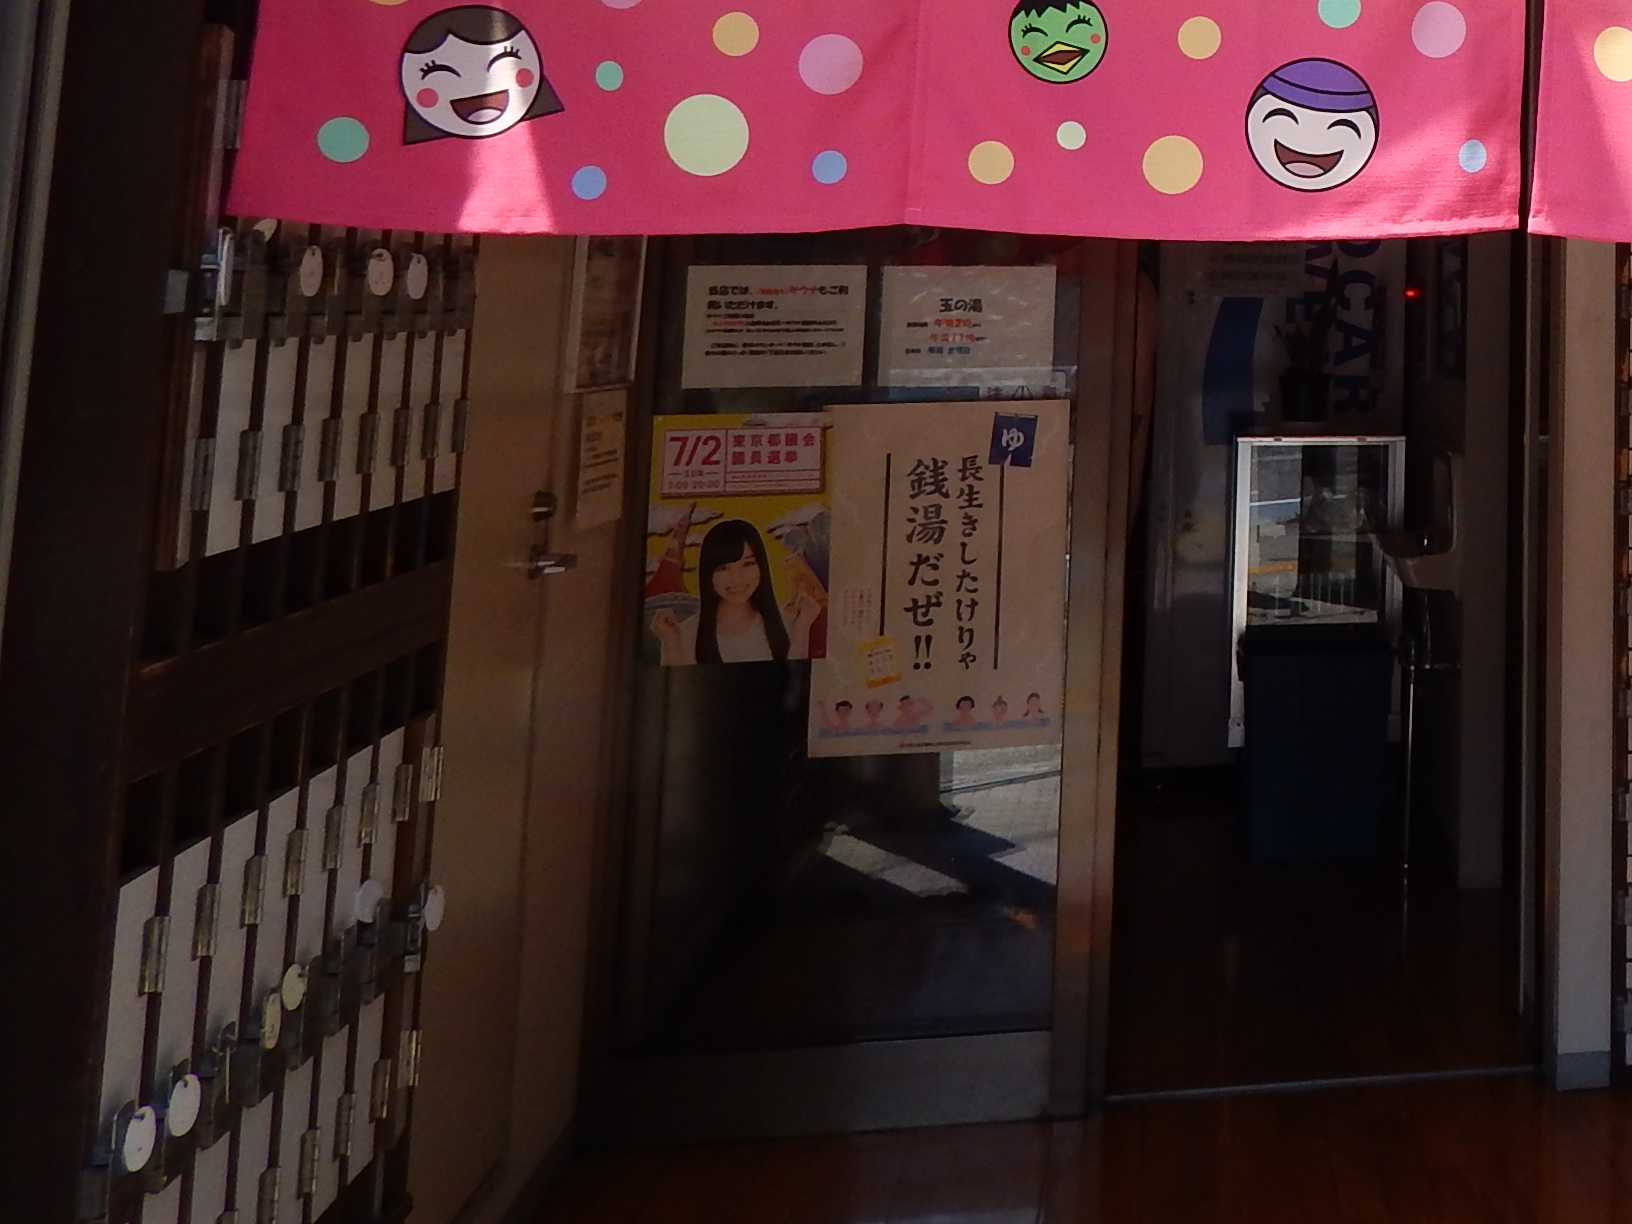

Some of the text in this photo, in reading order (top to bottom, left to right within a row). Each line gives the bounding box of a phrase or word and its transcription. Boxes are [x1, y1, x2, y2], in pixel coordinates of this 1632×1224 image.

[939, 297, 983, 314] 玉の湯
[668, 435, 723, 468] 7/2
[1001, 427, 1026, 452] ゆ
[955, 454, 985, 671] 長生きしたけりゃ
